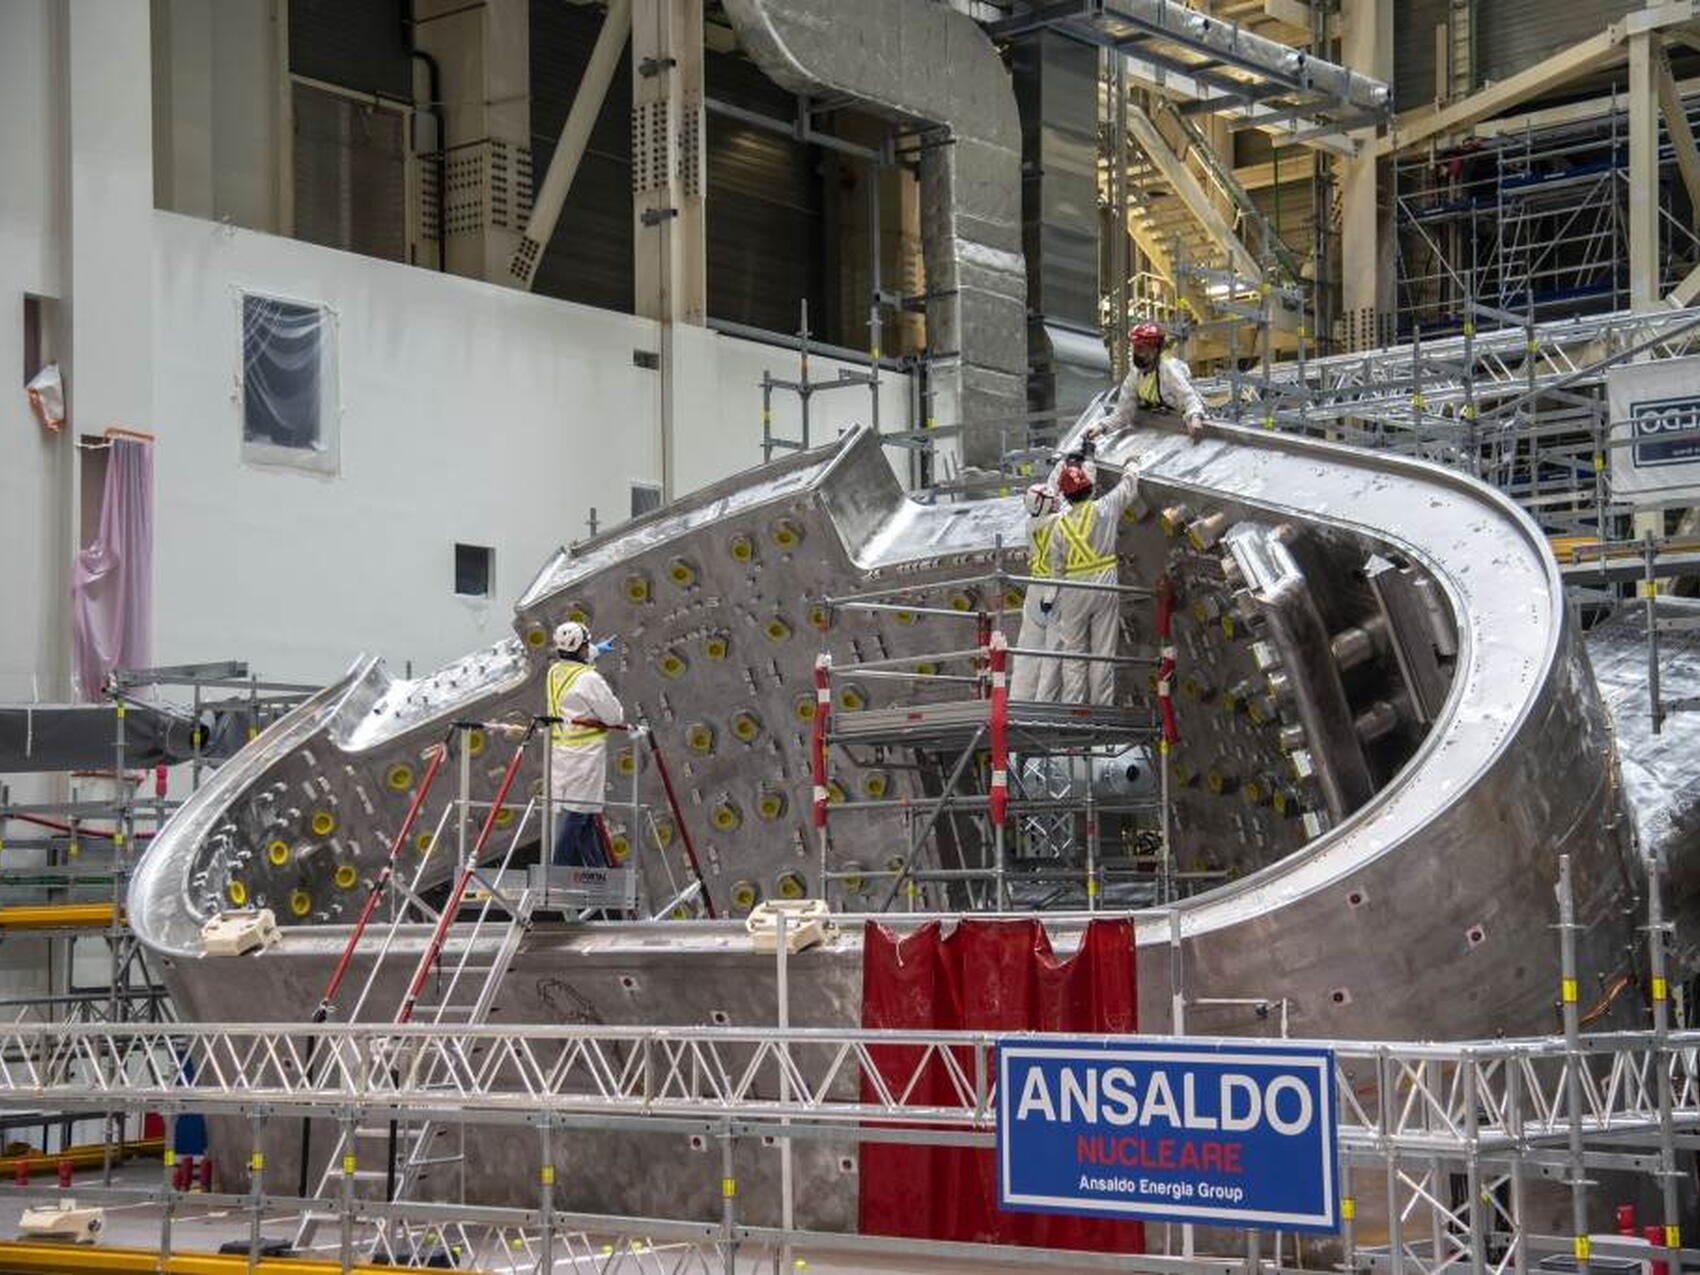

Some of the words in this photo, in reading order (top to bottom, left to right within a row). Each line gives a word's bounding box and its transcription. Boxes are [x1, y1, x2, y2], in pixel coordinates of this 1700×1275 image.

[1016, 1066, 1313, 1136] ANSALDO
[1076, 1135, 1244, 1173] NUCLEARE
[1079, 1175, 1136, 1194] Ansaldo
[1139, 1178, 1194, 1200] Energia
[1198, 1182, 1244, 1202] Group
